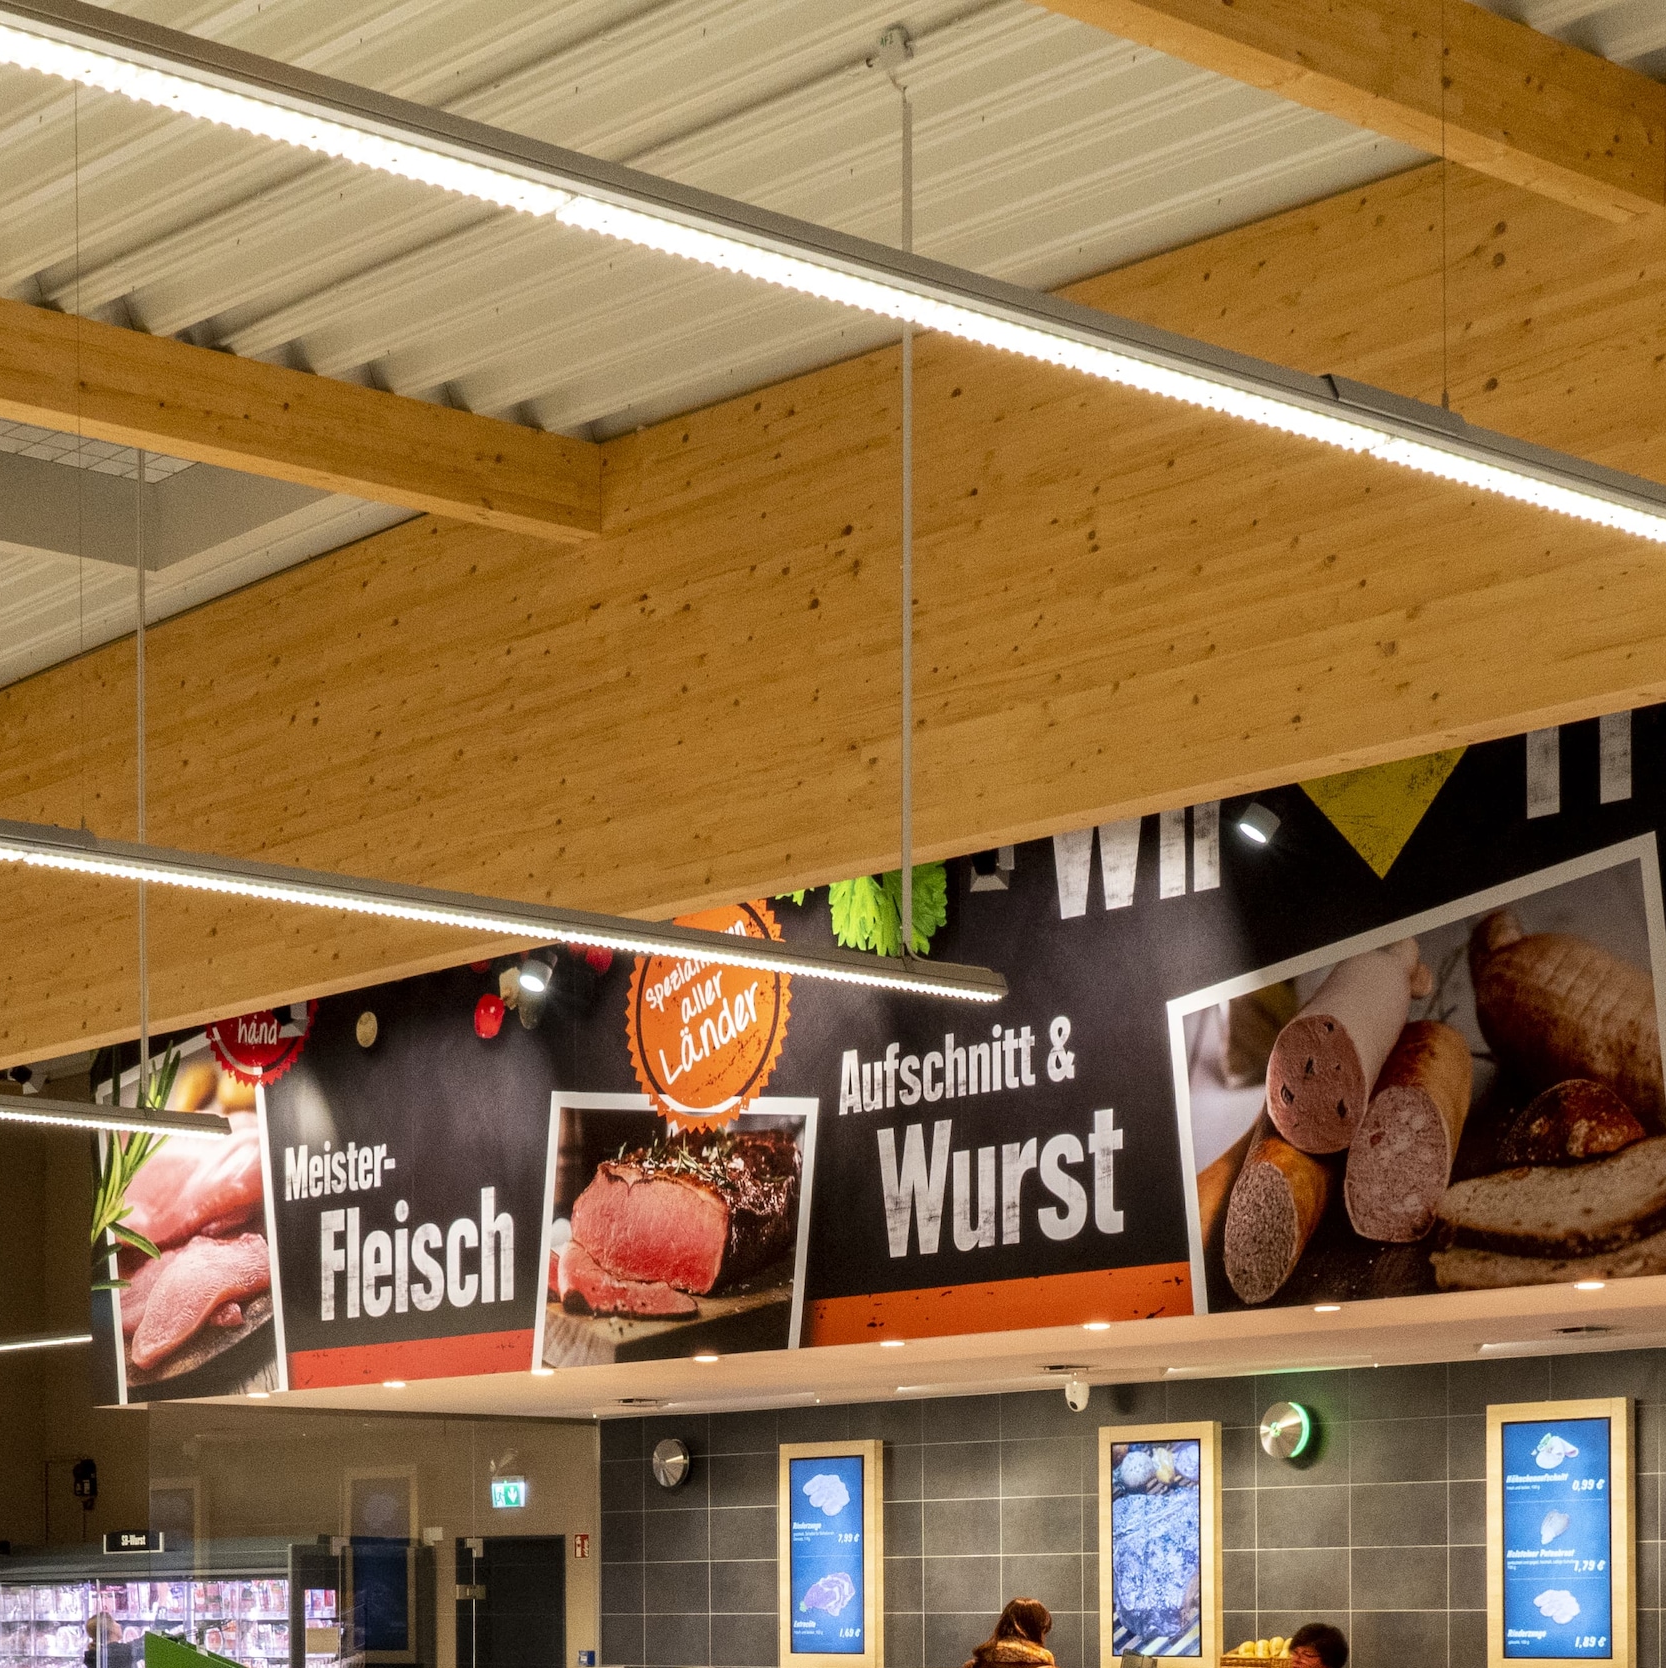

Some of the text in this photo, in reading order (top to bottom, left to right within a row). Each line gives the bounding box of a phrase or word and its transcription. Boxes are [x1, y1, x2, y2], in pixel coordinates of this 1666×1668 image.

[658, 981, 758, 1085] Länder
[681, 970, 722, 1024] aller
[838, 1015, 1076, 1117] Aufschnitt &
[284, 1139, 396, 1200] Meister-
[876, 1108, 1124, 1259] Wurst
[320, 1187, 514, 1323] Fleisch
[1572, 1479, 1595, 1491] 0,99
